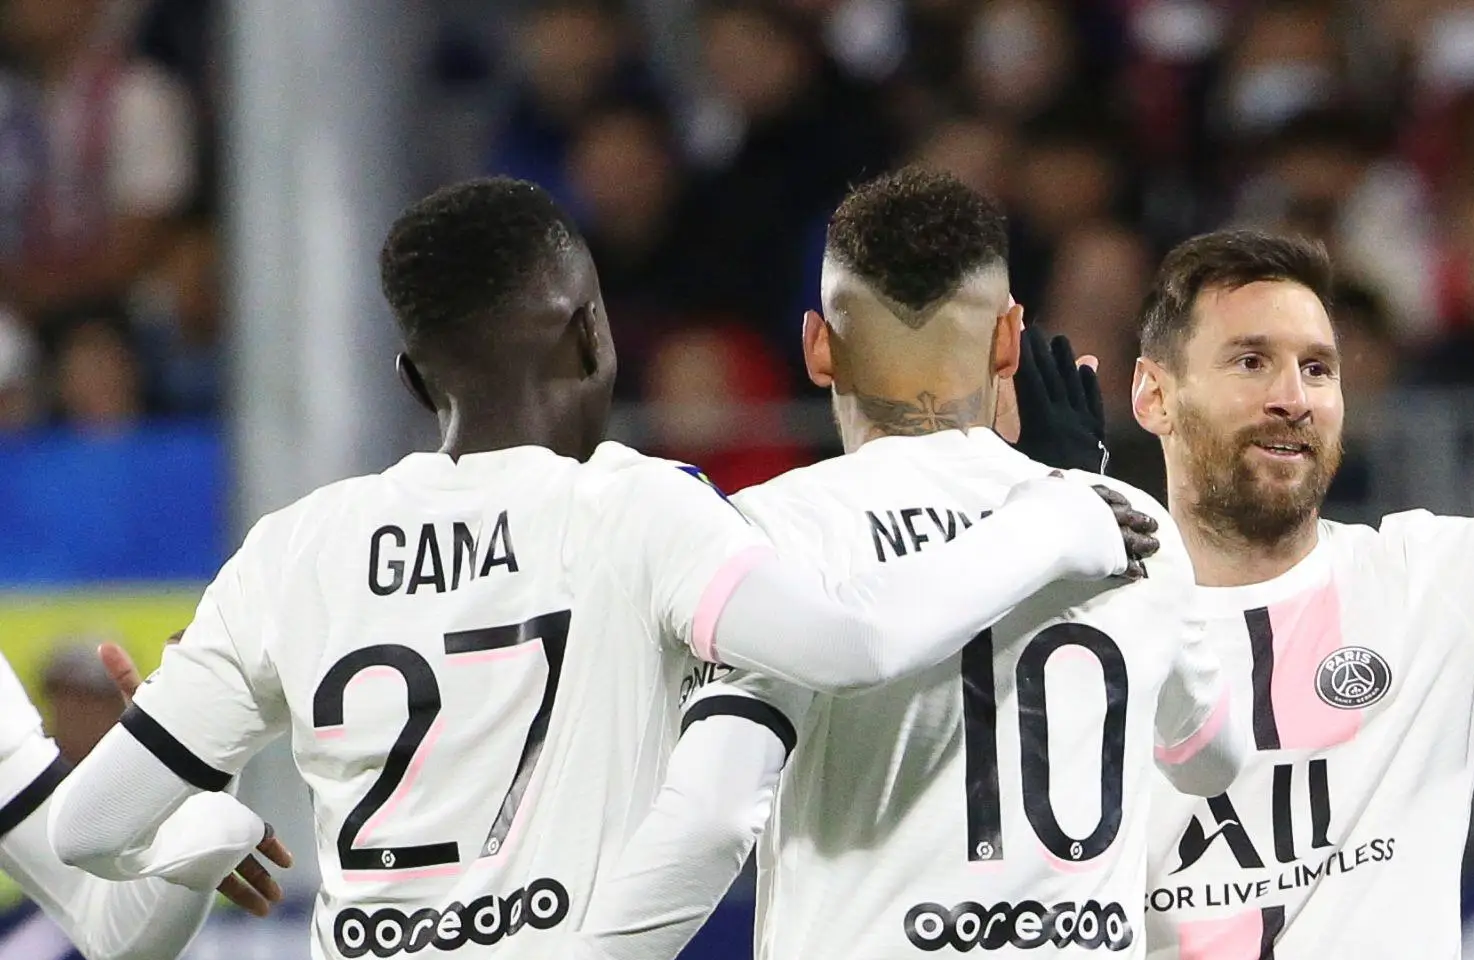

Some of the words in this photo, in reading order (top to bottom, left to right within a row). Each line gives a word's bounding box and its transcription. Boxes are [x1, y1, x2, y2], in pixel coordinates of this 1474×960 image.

[368, 509, 520, 597] GANA
[1325, 650, 1373, 673] PARIS
[312, 608, 573, 871] 27
[960, 621, 1130, 863] 10
[333, 876, 571, 959] ooredoo
[903, 899, 1135, 952] ooredoo
[1206, 879, 1271, 908] LIVE
